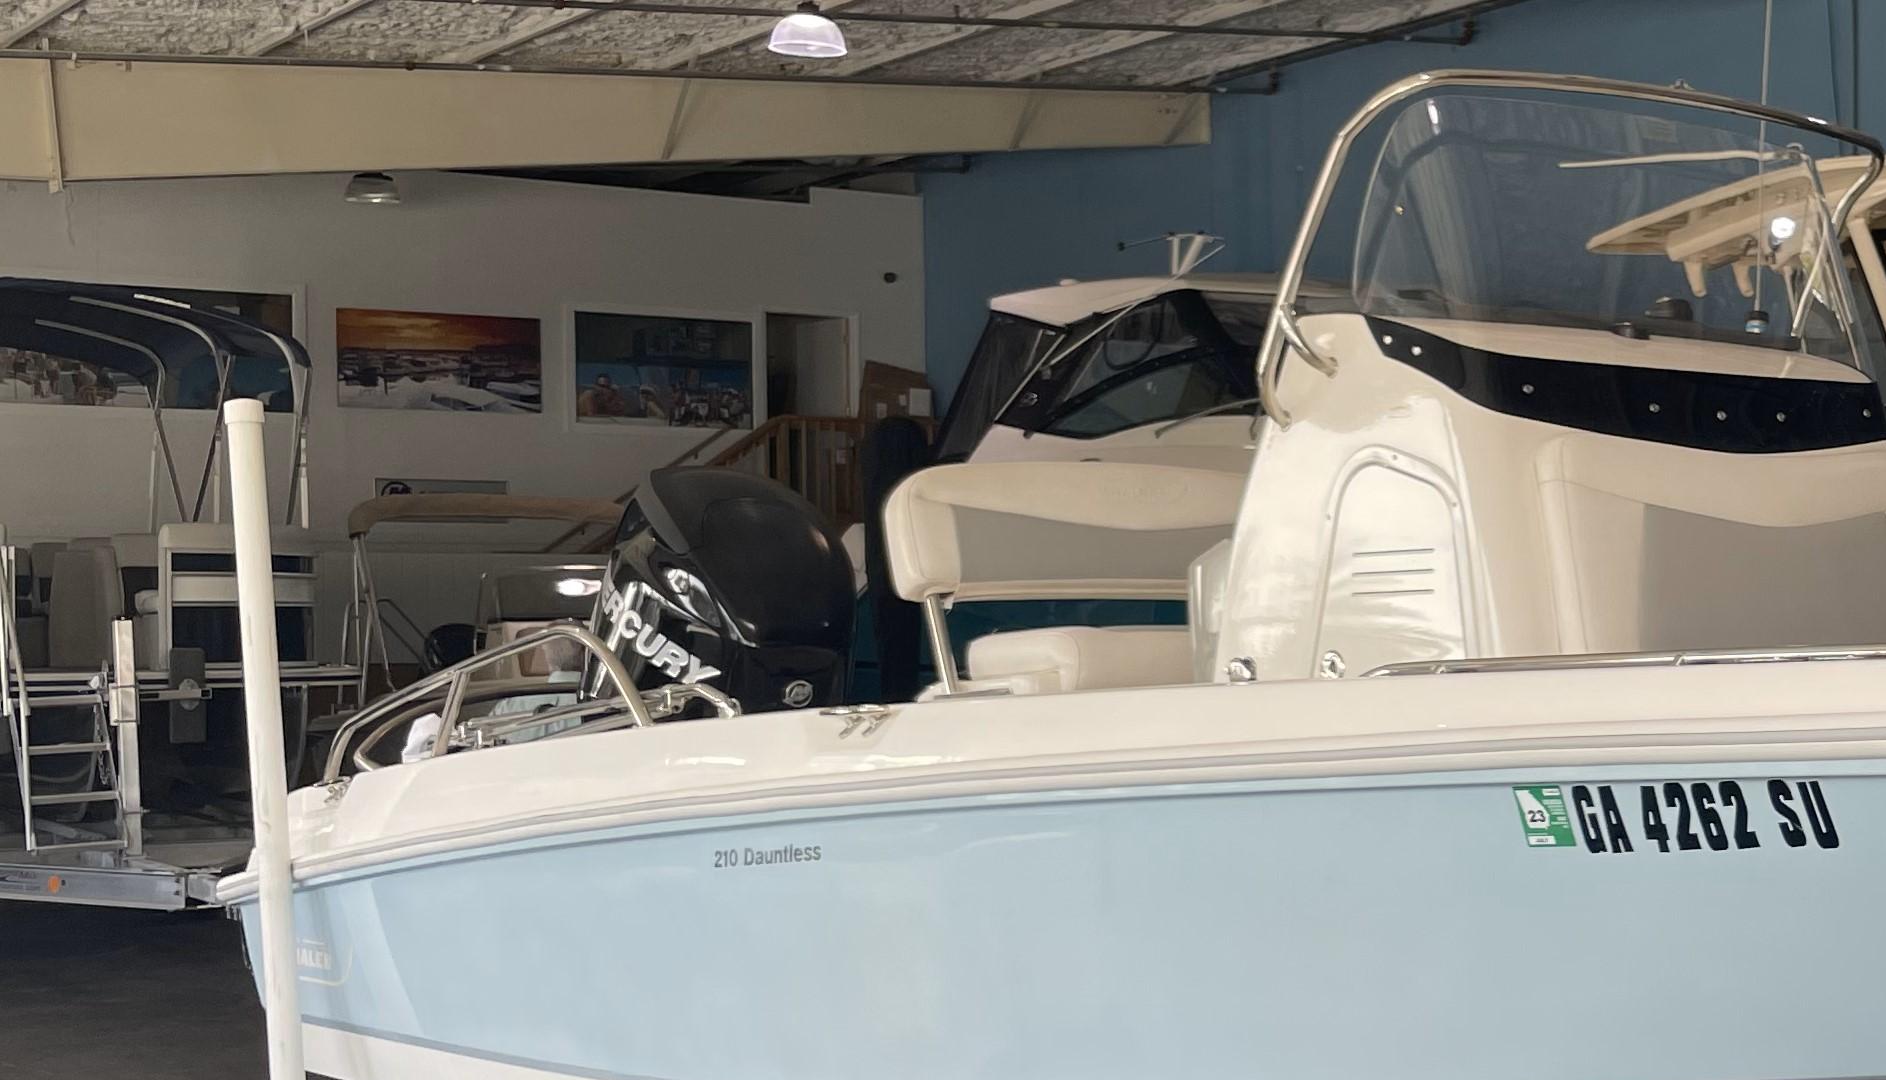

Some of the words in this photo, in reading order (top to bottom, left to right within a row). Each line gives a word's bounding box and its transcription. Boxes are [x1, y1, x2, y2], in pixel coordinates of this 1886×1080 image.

[602, 562, 722, 685] ERCURY
[1527, 809, 1546, 823] 23
[1572, 784, 1634, 854] GA
[1640, 780, 1761, 853] 4262
[1767, 779, 1840, 849] SU
[714, 848, 739, 868] 210
[744, 844, 822, 866] Dauntless
